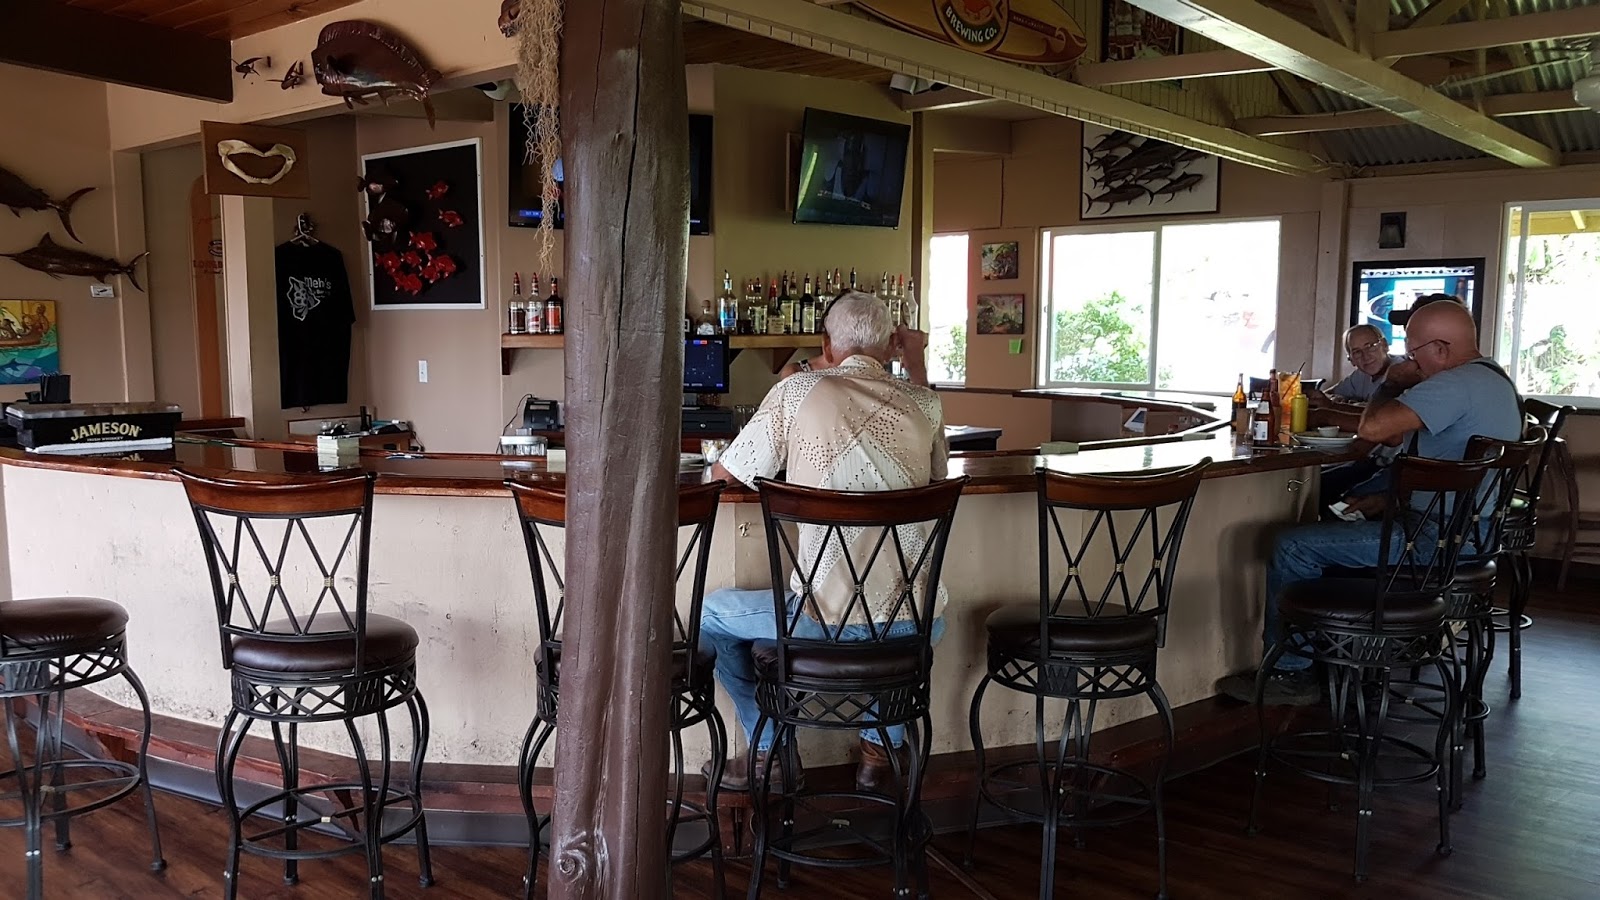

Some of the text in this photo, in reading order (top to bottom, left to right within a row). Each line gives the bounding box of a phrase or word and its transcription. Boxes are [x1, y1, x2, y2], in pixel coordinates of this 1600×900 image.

[945, 6, 984, 43] BREWING
[304, 276, 332, 290] Meh's
[70, 422, 140, 441] JAMESON
